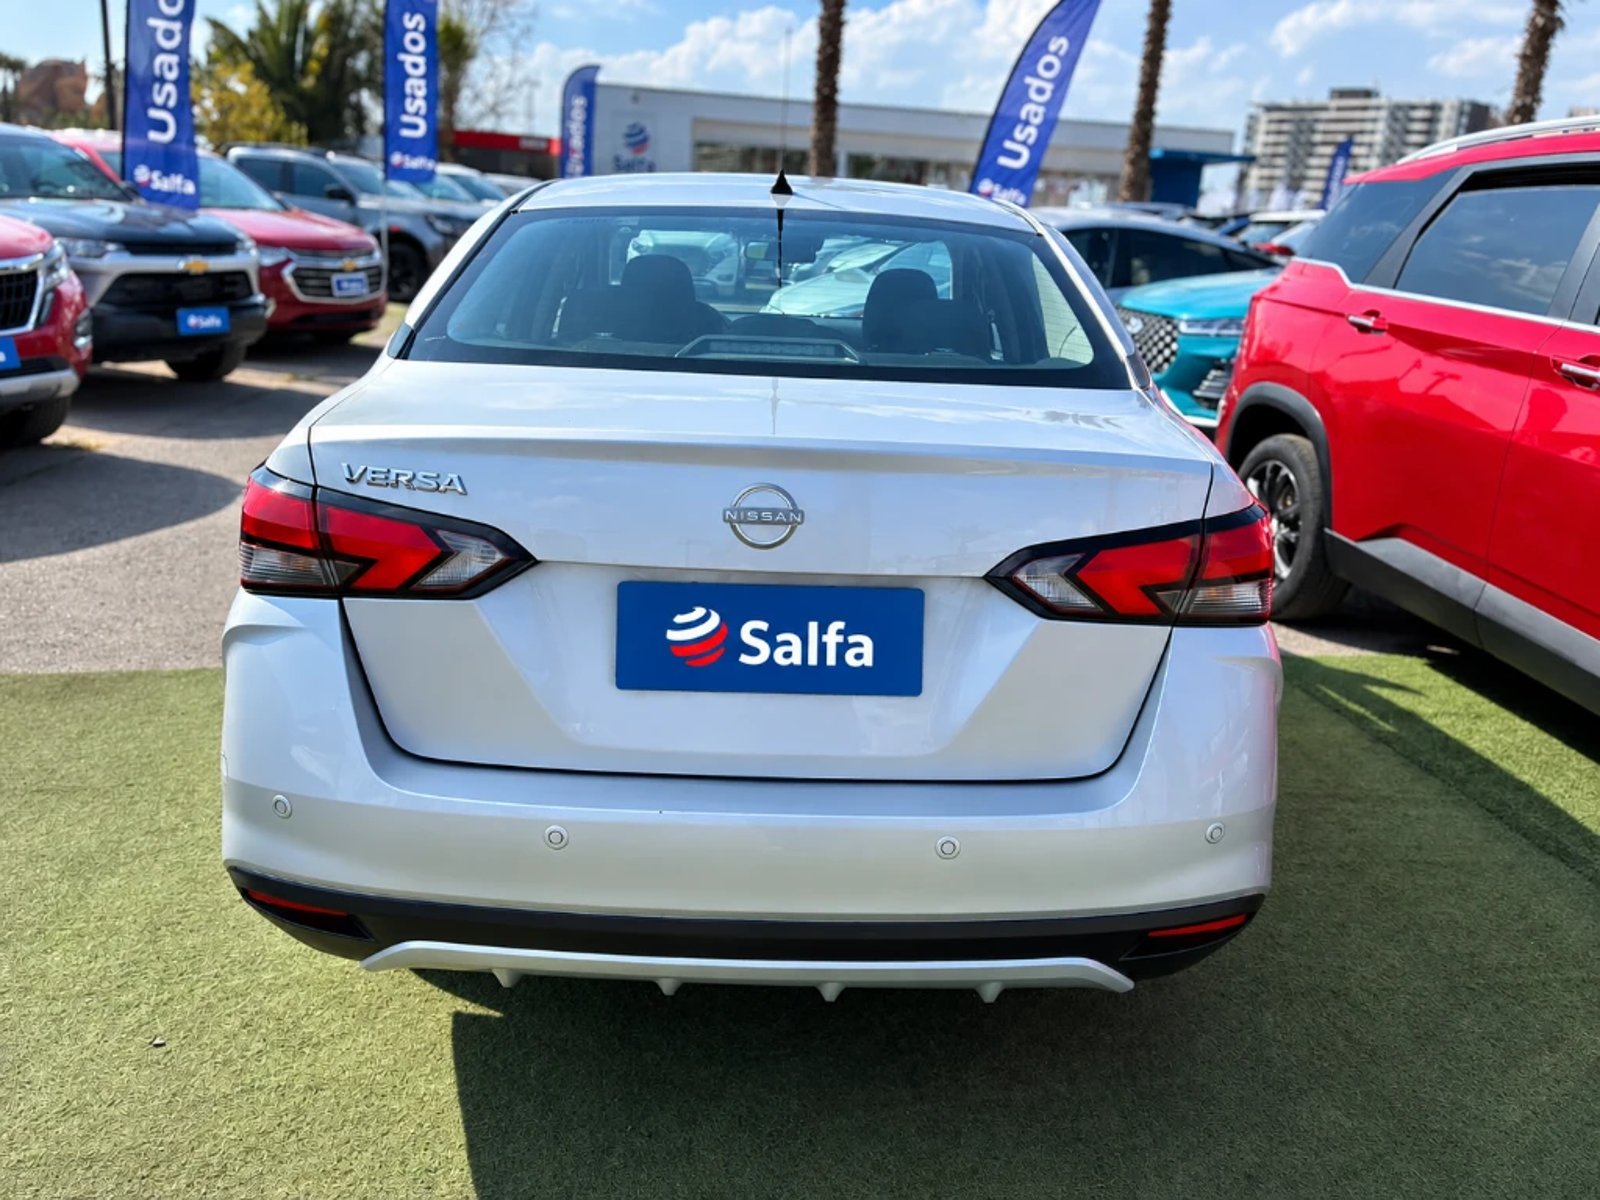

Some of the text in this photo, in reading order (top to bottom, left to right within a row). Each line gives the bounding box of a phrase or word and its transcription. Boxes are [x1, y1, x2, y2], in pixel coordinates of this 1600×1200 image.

[397, 12, 427, 139] Usados
[997, 35, 1069, 170] Usados
[149, 170, 196, 195] Salfa
[341, 462, 468, 495] VERSA
[725, 510, 802, 523] NISSAN
[738, 620, 875, 667] Salfa
